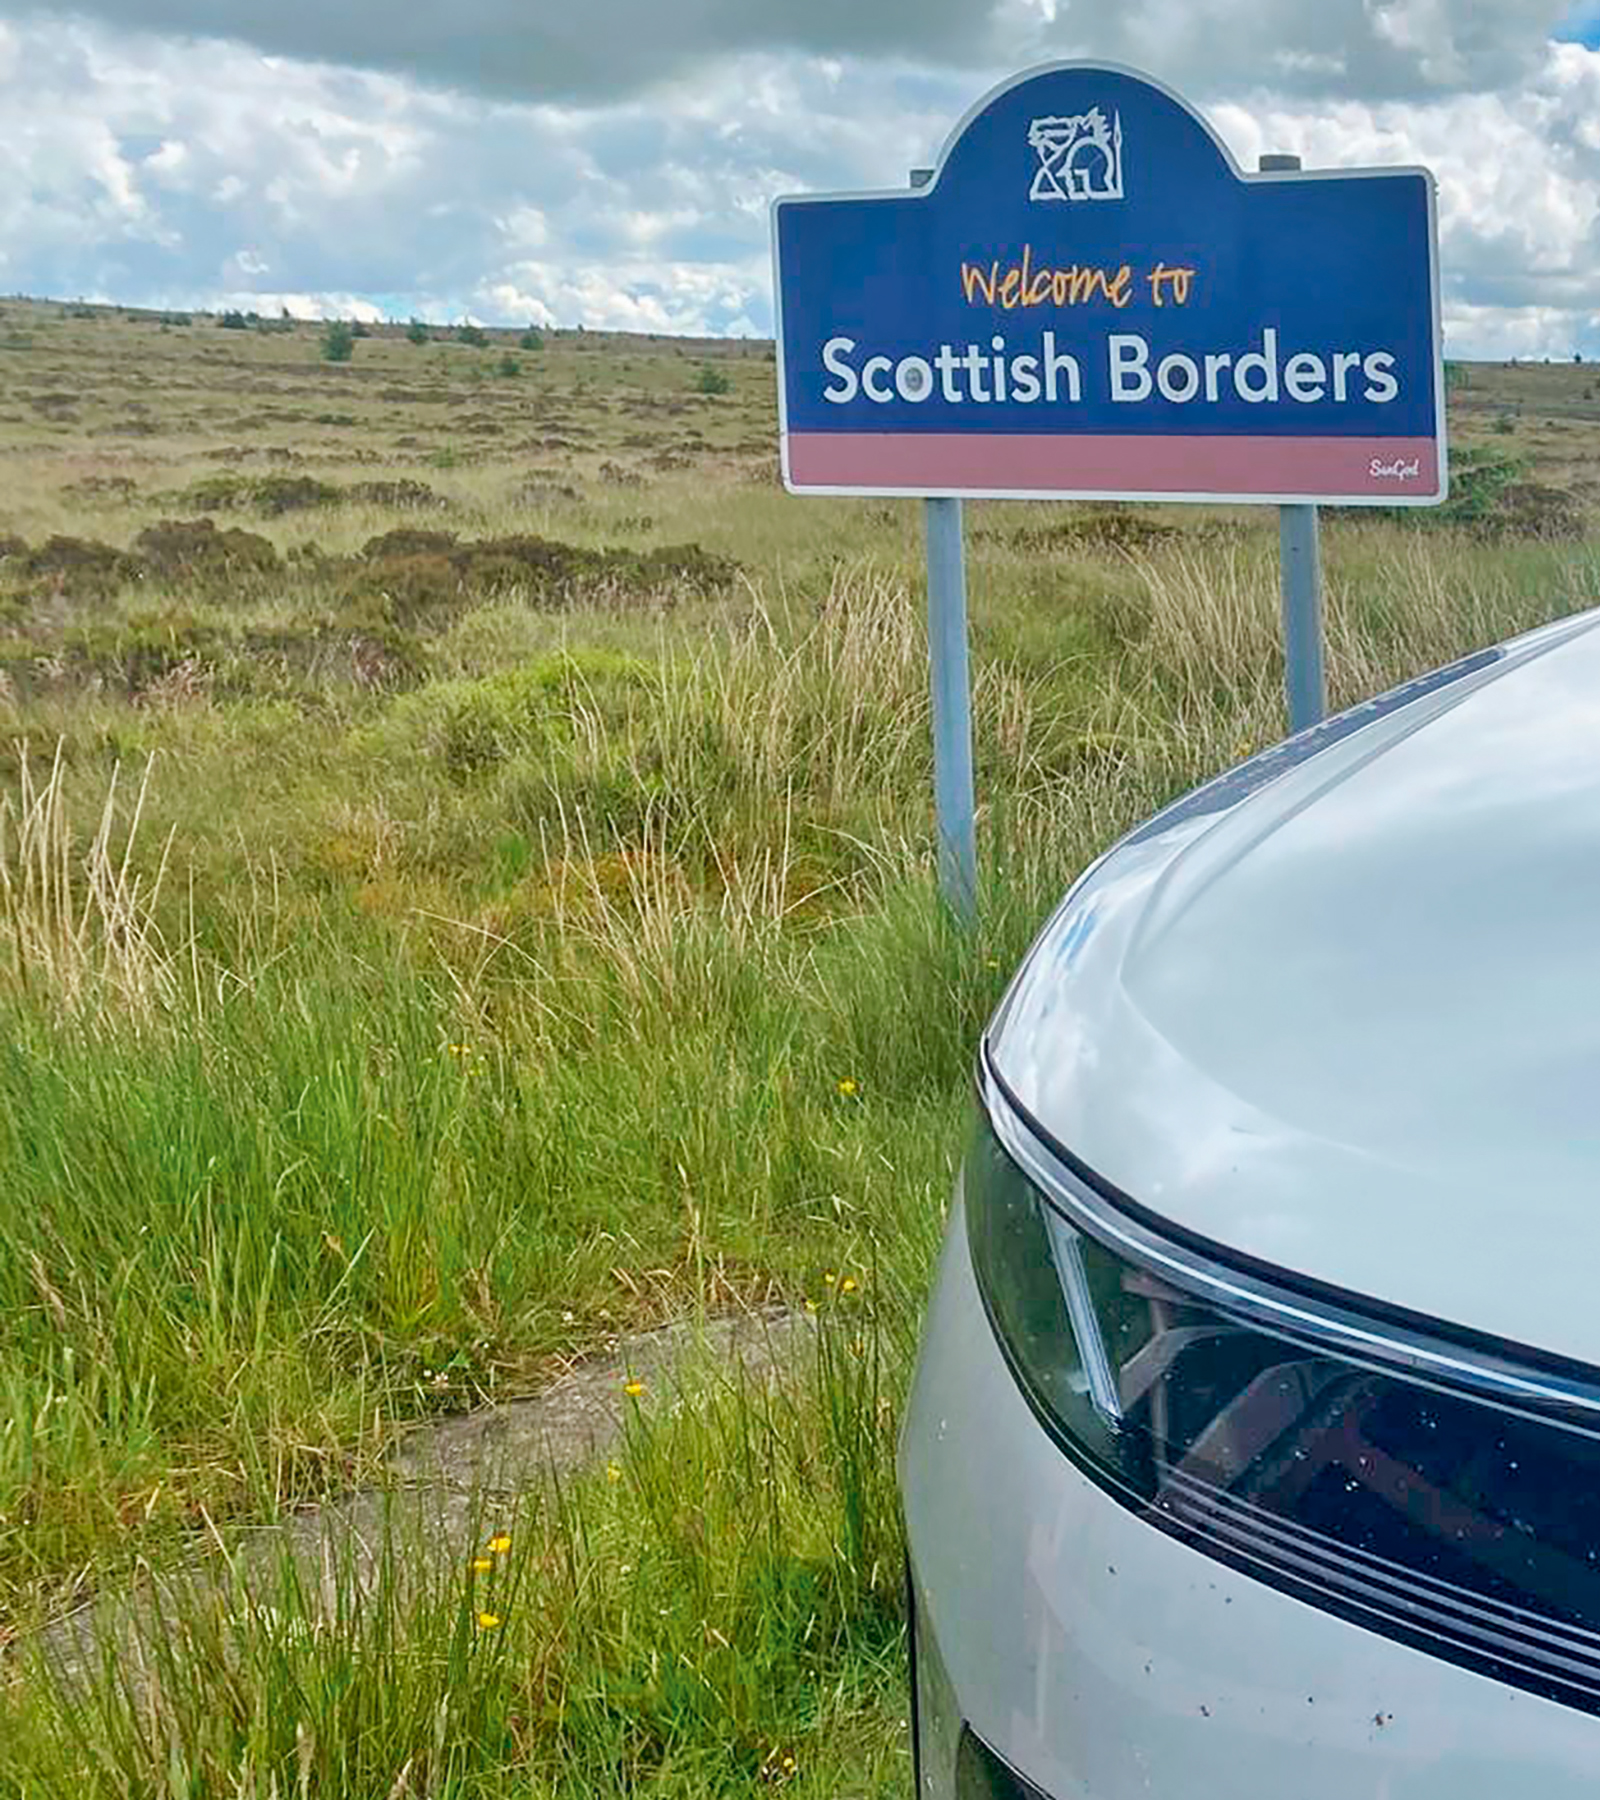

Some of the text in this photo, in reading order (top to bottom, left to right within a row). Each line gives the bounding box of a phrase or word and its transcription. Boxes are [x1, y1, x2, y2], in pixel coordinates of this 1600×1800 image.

[961, 244, 1197, 308] Welcome to
[822, 328, 1399, 404] Scottish Borders
